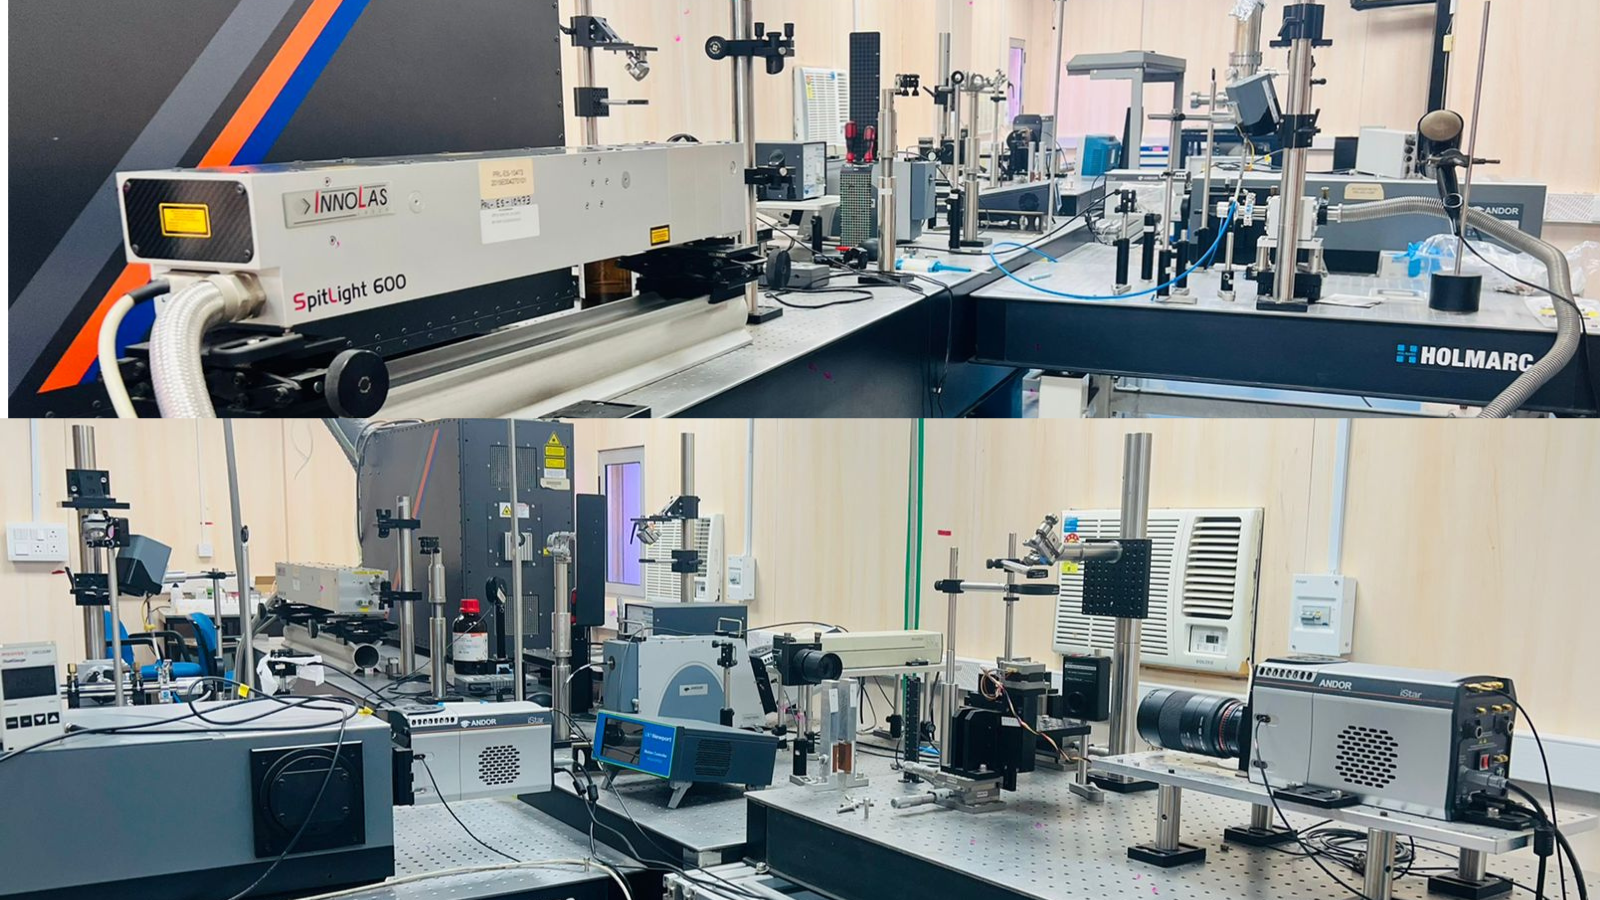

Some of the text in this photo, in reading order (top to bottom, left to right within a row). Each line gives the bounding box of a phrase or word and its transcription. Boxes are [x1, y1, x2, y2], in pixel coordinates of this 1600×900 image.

[1485, 206, 1519, 215] ANDOR
[293, 273, 407, 313] SpitLight 600
[1420, 345, 1534, 372] HOLMARC
[1318, 679, 1353, 690] ANDOR
[1399, 688, 1423, 700] iStar
[471, 718, 497, 727] ANDOR
[527, 716, 545, 725] iStar
